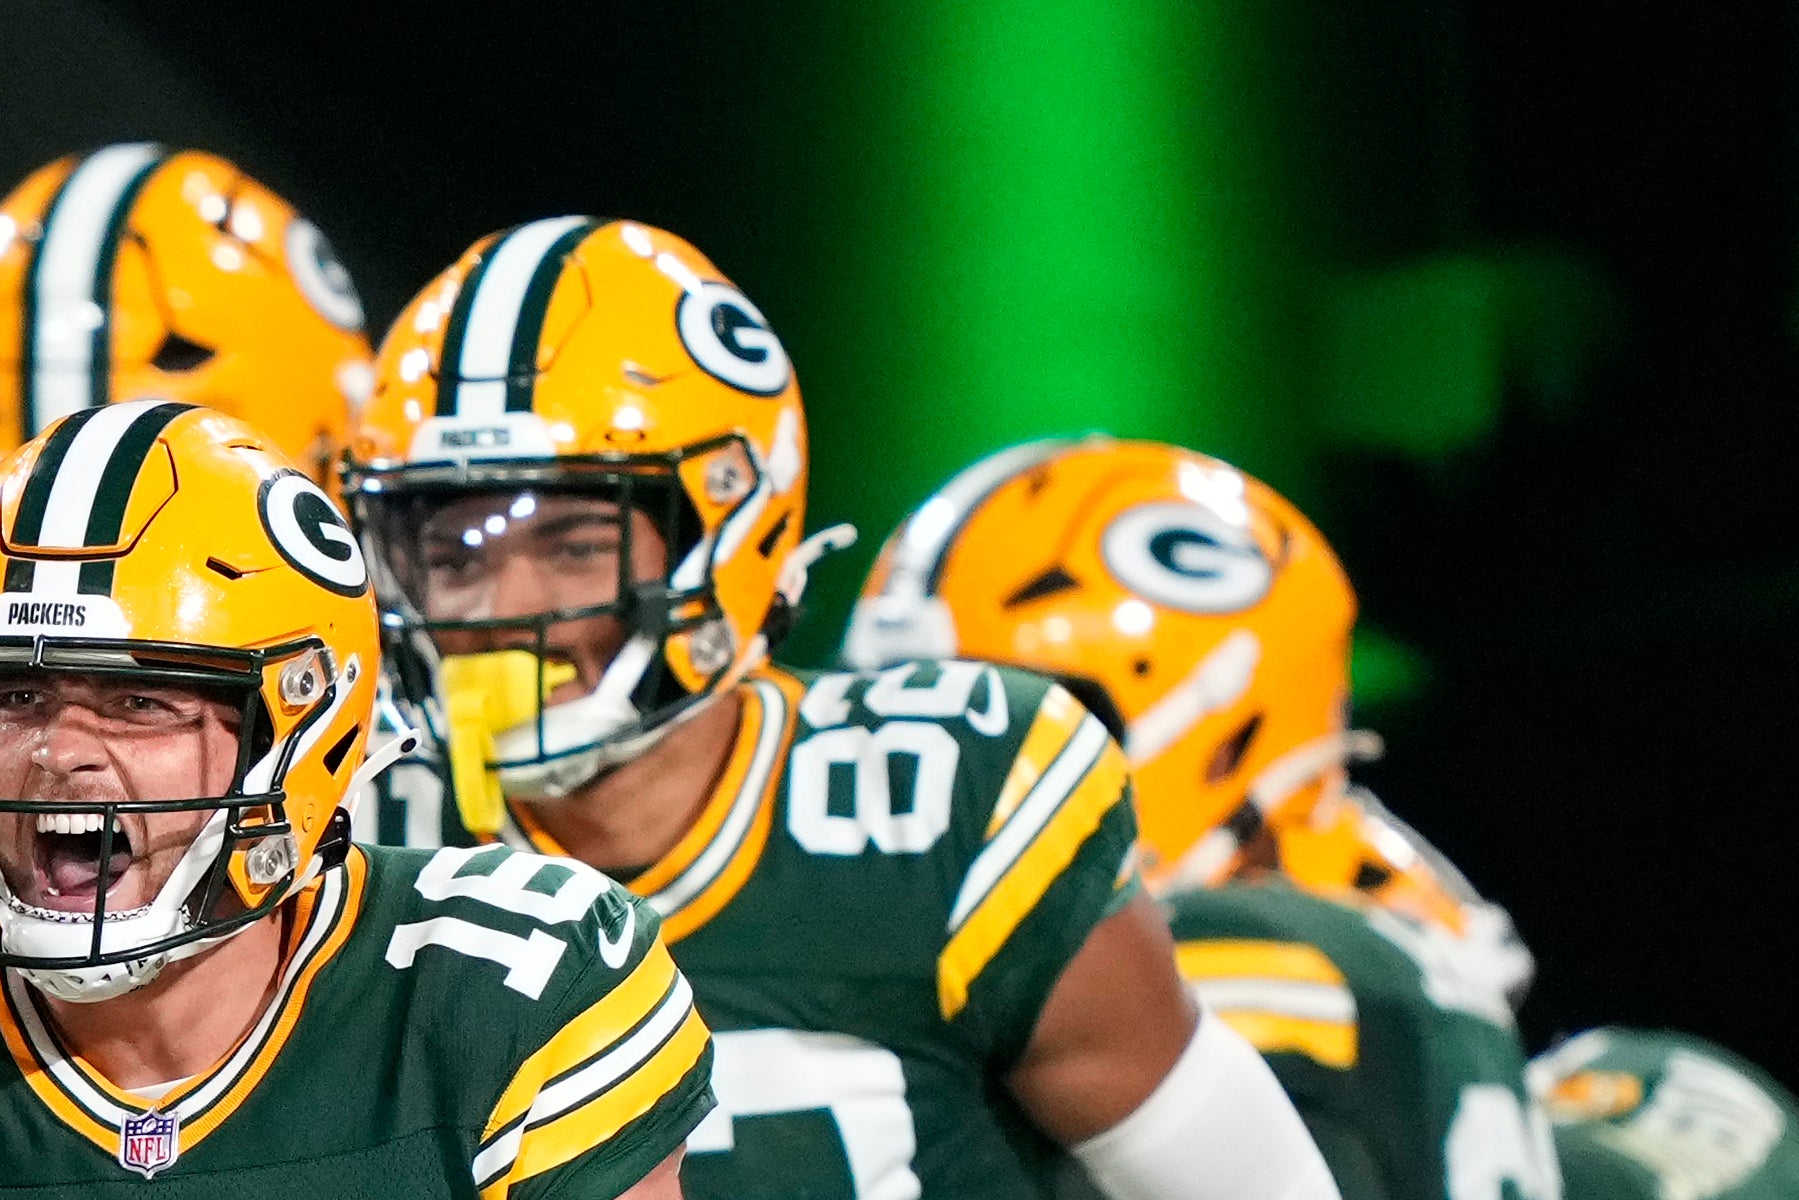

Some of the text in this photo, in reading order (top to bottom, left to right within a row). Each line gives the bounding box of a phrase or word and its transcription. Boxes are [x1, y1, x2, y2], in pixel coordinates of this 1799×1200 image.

[678, 282, 788, 392] G
[265, 473, 367, 588] G
[1102, 502, 1273, 613] G
[7, 602, 86, 627] PACKERS
[385, 842, 612, 1000] 16
[128, 1136, 166, 1165] NFL
